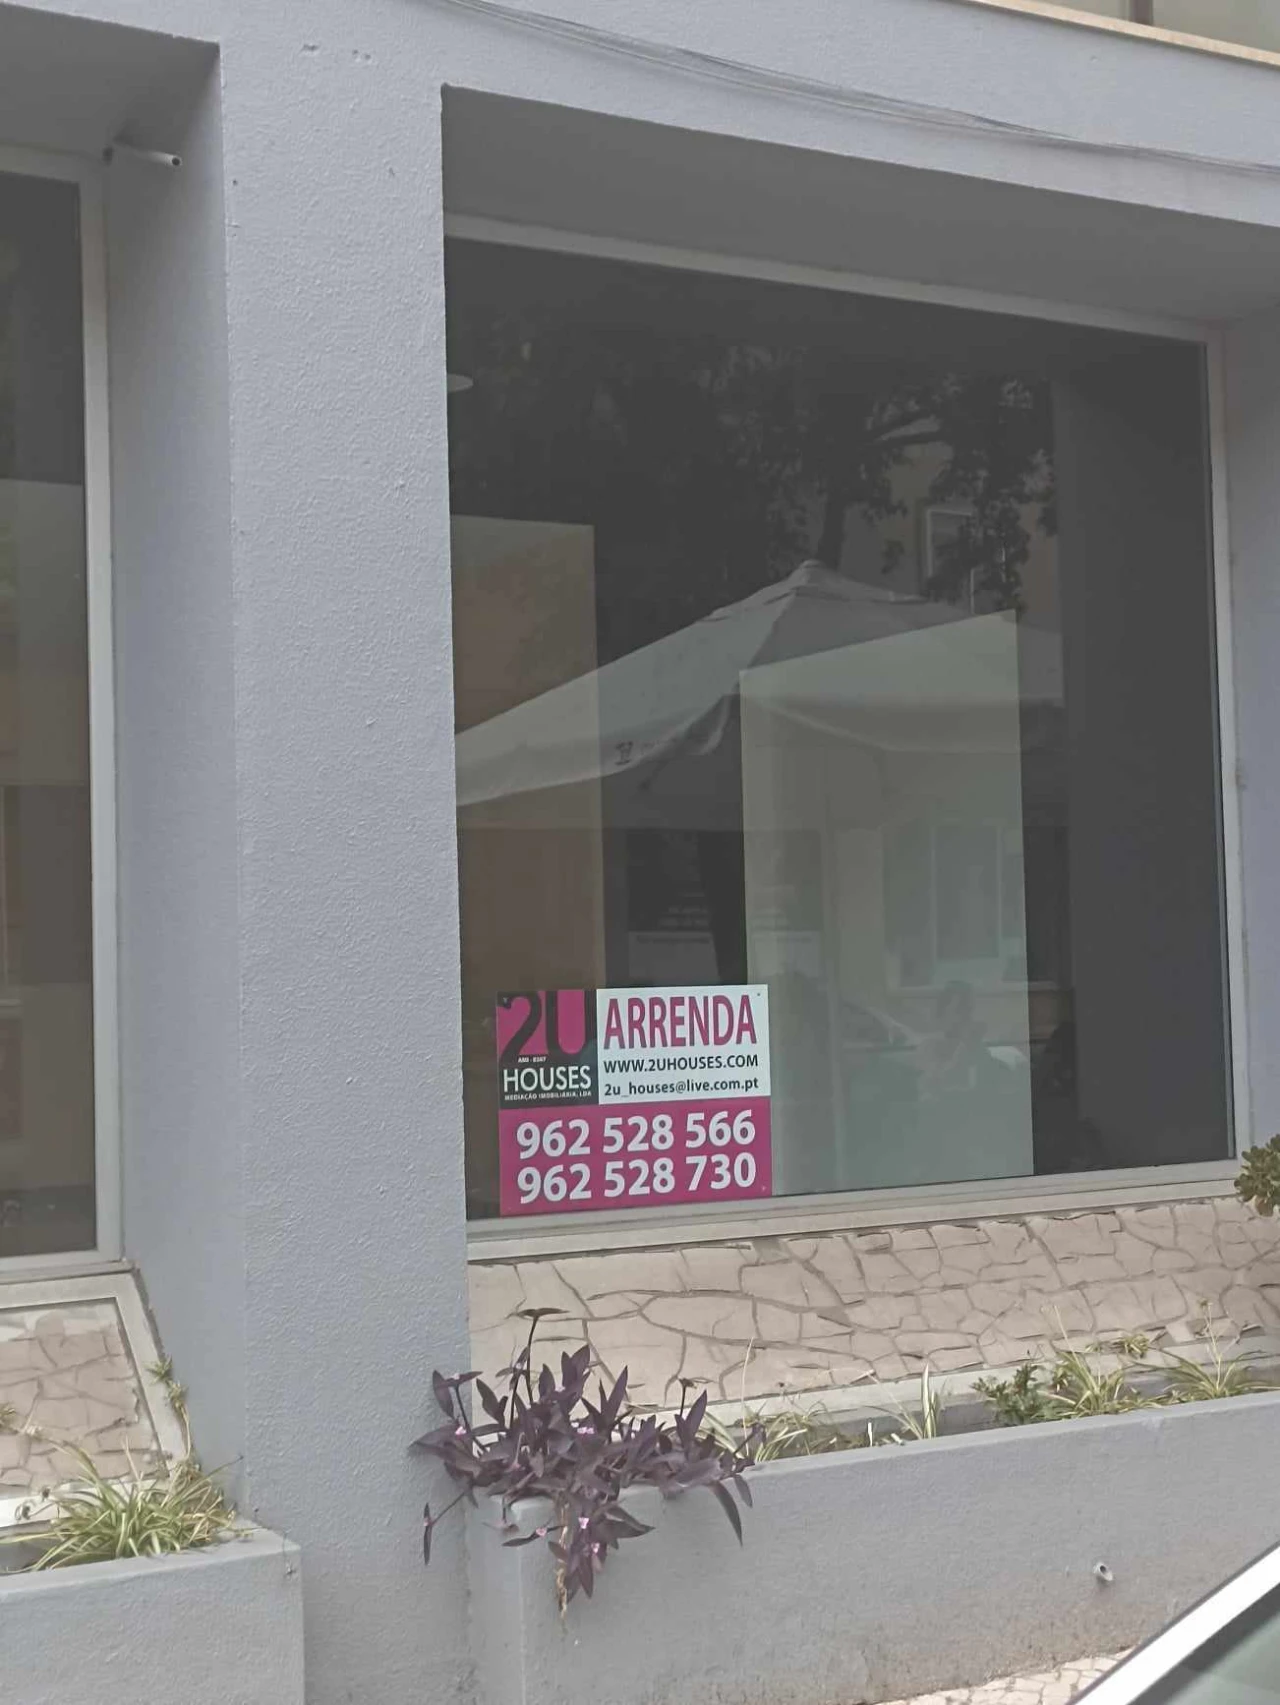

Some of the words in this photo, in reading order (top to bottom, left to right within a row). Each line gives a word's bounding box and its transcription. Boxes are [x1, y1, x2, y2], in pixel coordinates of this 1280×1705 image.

[496, 990, 597, 1060] 2U
[603, 994, 757, 1050] ARRENDA
[503, 1065, 592, 1093] HOUSES
[603, 1054, 759, 1074] WWW.2UHOUSES.COM
[604, 1077, 759, 1098] 2u_houses@live.com.pt
[516, 1118, 591, 1160] 962
[602, 1114, 674, 1154] 528
[685, 1109, 756, 1149] 566
[517, 1163, 592, 1205] 962
[604, 1157, 676, 1198] 528
[685, 1152, 756, 1191] 730
